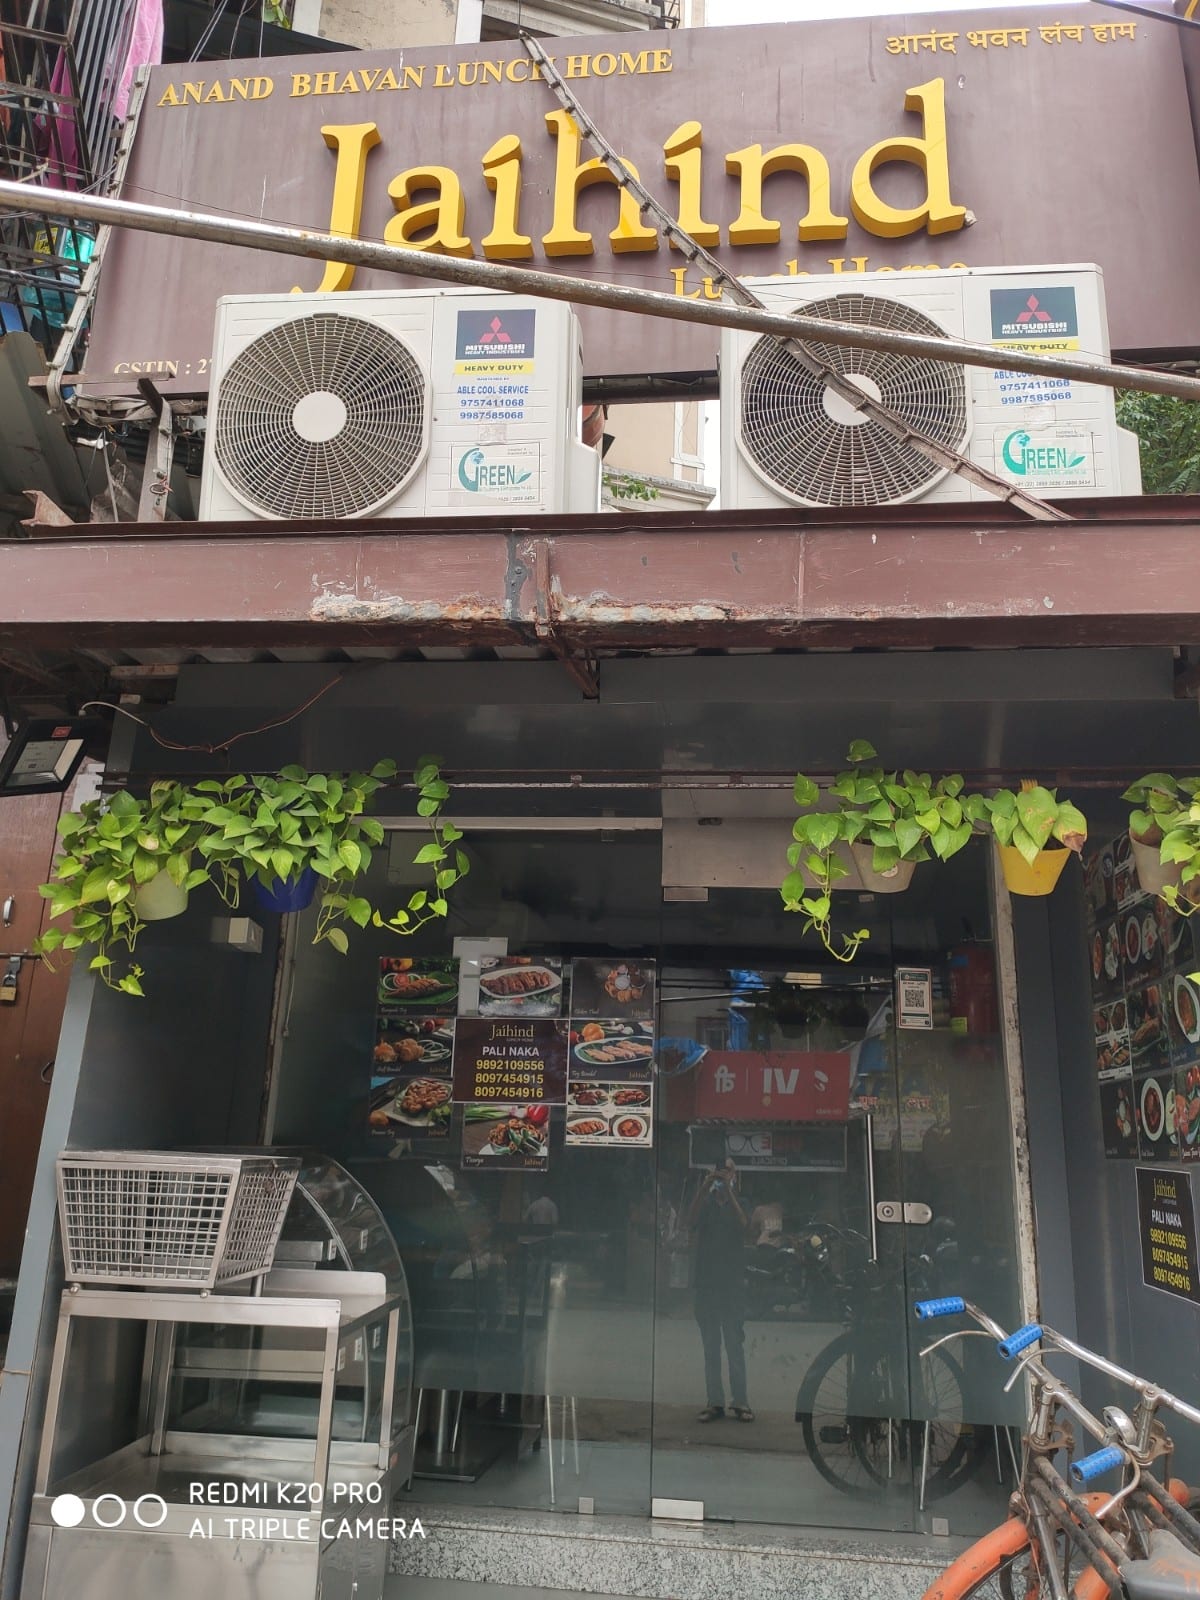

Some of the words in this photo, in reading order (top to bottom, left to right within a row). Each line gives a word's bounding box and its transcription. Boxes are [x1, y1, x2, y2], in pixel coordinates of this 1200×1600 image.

[885, 29, 959, 55] आनंद
[966, 27, 1030, 49] भवन
[1038, 21, 1085, 44] लंच
[157, 76, 274, 107] ANAND
[289, 65, 425, 97] BHAVAN
[564, 49, 673, 79] HOME
[291, 77, 966, 293] Jaihind
[1002, 322, 1067, 330] MITSUBISHI
[114, 361, 179, 375] GSTIN
[457, 385, 475, 394] ABLE
[478, 385, 496, 394] COOL
[498, 385, 529, 394] SERVICE
[1000, 380, 1070, 391] 9757411068
[460, 399, 525, 407] 9757411068
[460, 411, 524, 419] 9987585068
[1003, 429, 1067, 476] GREEN
[458, 447, 515, 492] GREEN
[489, 1024, 534, 1041] Jaihind
[482, 1046, 506, 1056] PALI
[509, 1047, 539, 1057] NAKA
[476, 1060, 544, 1071] 9892109556
[475, 1073, 544, 1084] 8097454915
[474, 1087, 543, 1098] 8097454916
[1151, 1209, 1165, 1224] PALI
[1165, 1212, 1183, 1228] NAKA
[1150, 1228, 1187, 1250] 9892109556
